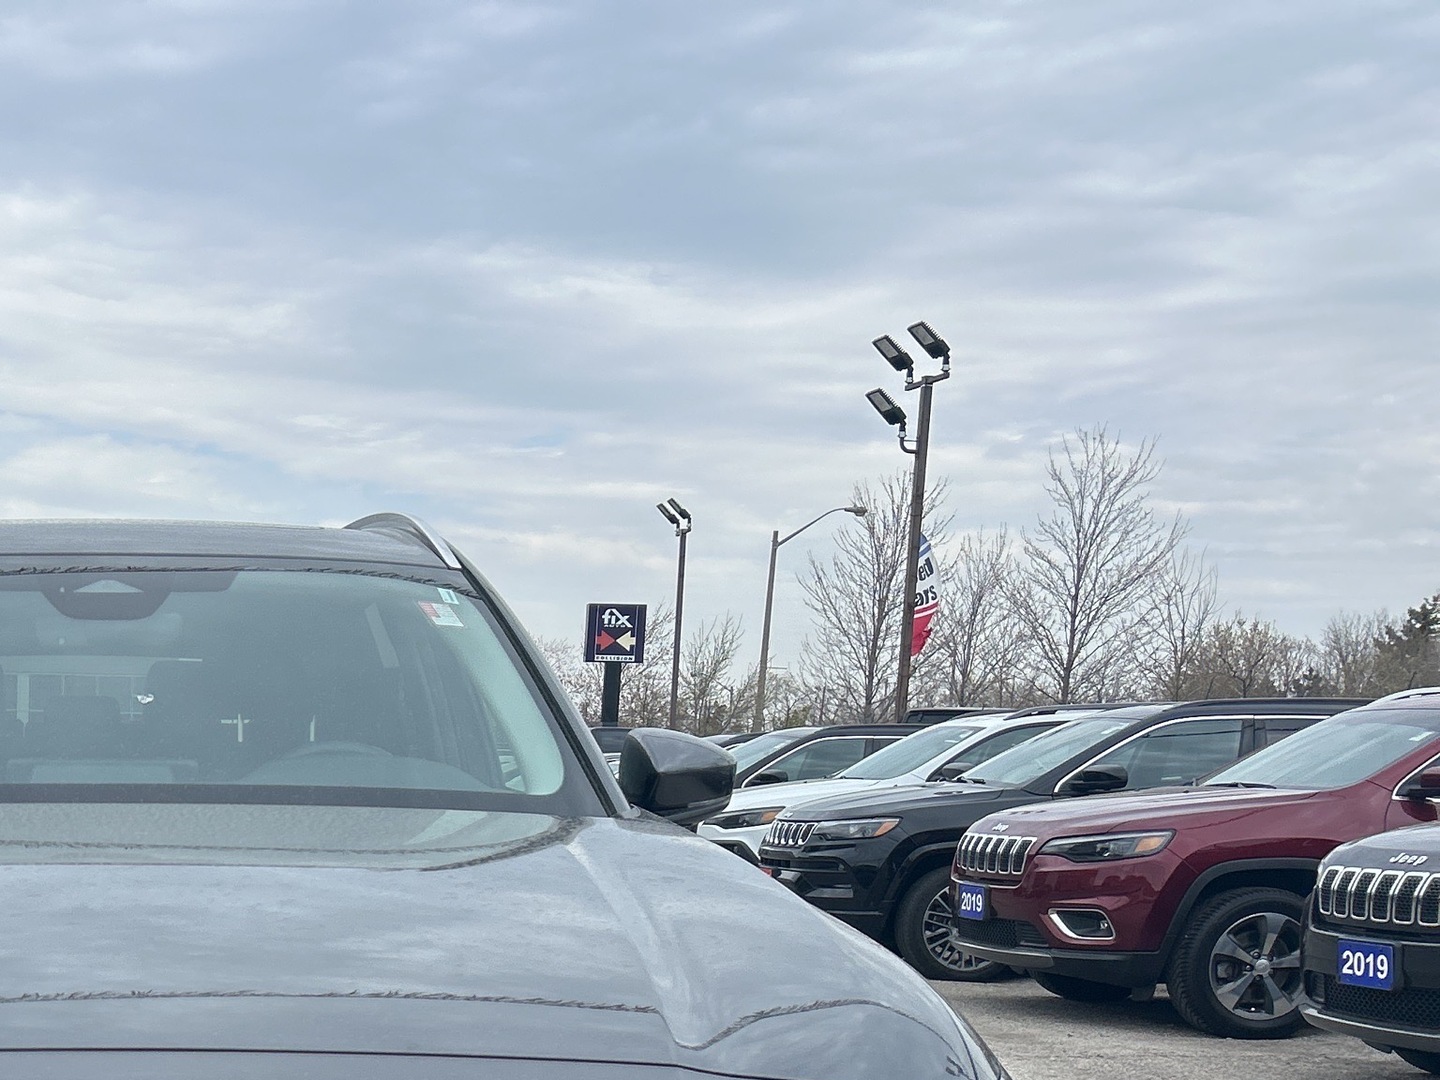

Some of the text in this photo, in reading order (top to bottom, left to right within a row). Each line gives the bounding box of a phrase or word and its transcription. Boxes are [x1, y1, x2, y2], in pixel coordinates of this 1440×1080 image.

[601, 608, 633, 628] fix
[1389, 852, 1428, 866] Jeep
[961, 891, 983, 912] 2019
[1341, 950, 1389, 979] 2019
